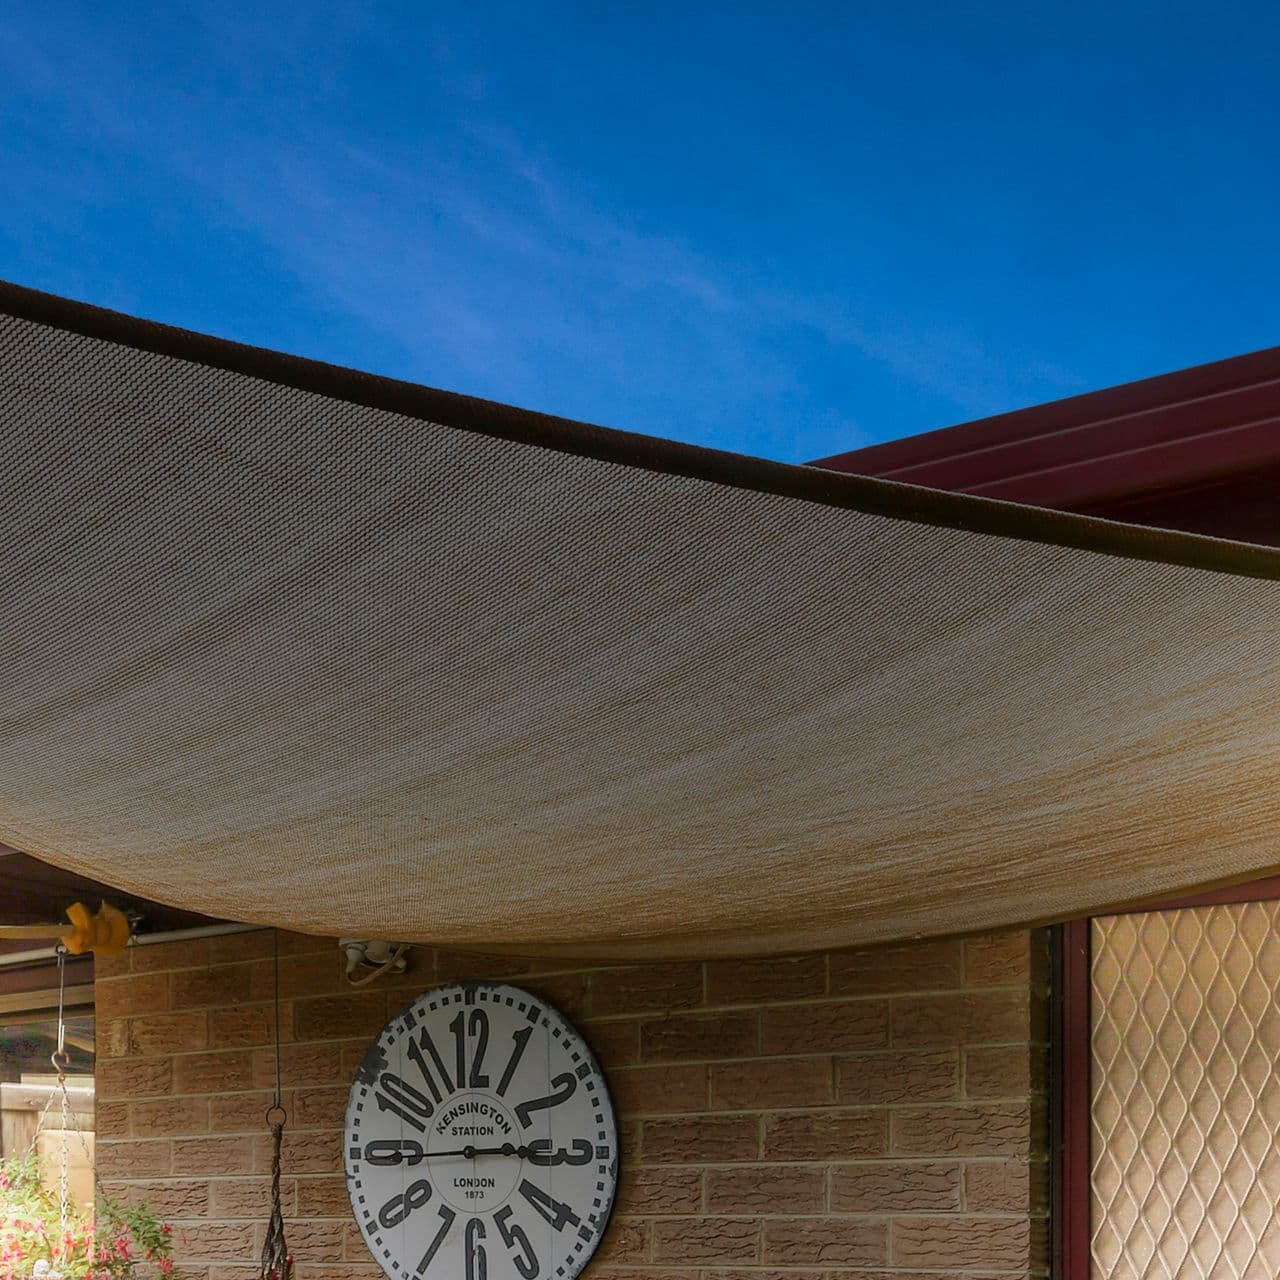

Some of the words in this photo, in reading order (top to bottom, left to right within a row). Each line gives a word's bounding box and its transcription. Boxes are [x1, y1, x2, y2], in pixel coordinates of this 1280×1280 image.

[408, 1025, 456, 1104] 11
[449, 1008, 490, 1089] 12
[495, 1025, 534, 1098] 1
[374, 1072, 435, 1133] 10
[436, 1102, 512, 1135] KENSINGTON
[513, 1072, 577, 1129] 2
[364, 1139, 424, 1167] 9
[451, 1126, 494, 1136] STATION
[526, 1139, 594, 1166] 3
[378, 1179, 433, 1229] 8
[453, 1177, 495, 1189] LONDON
[464, 1190, 485, 1200] 1873
[518, 1179, 581, 1232] 4
[416, 1204, 457, 1276] 7
[492, 1204, 540, 1280] 5
